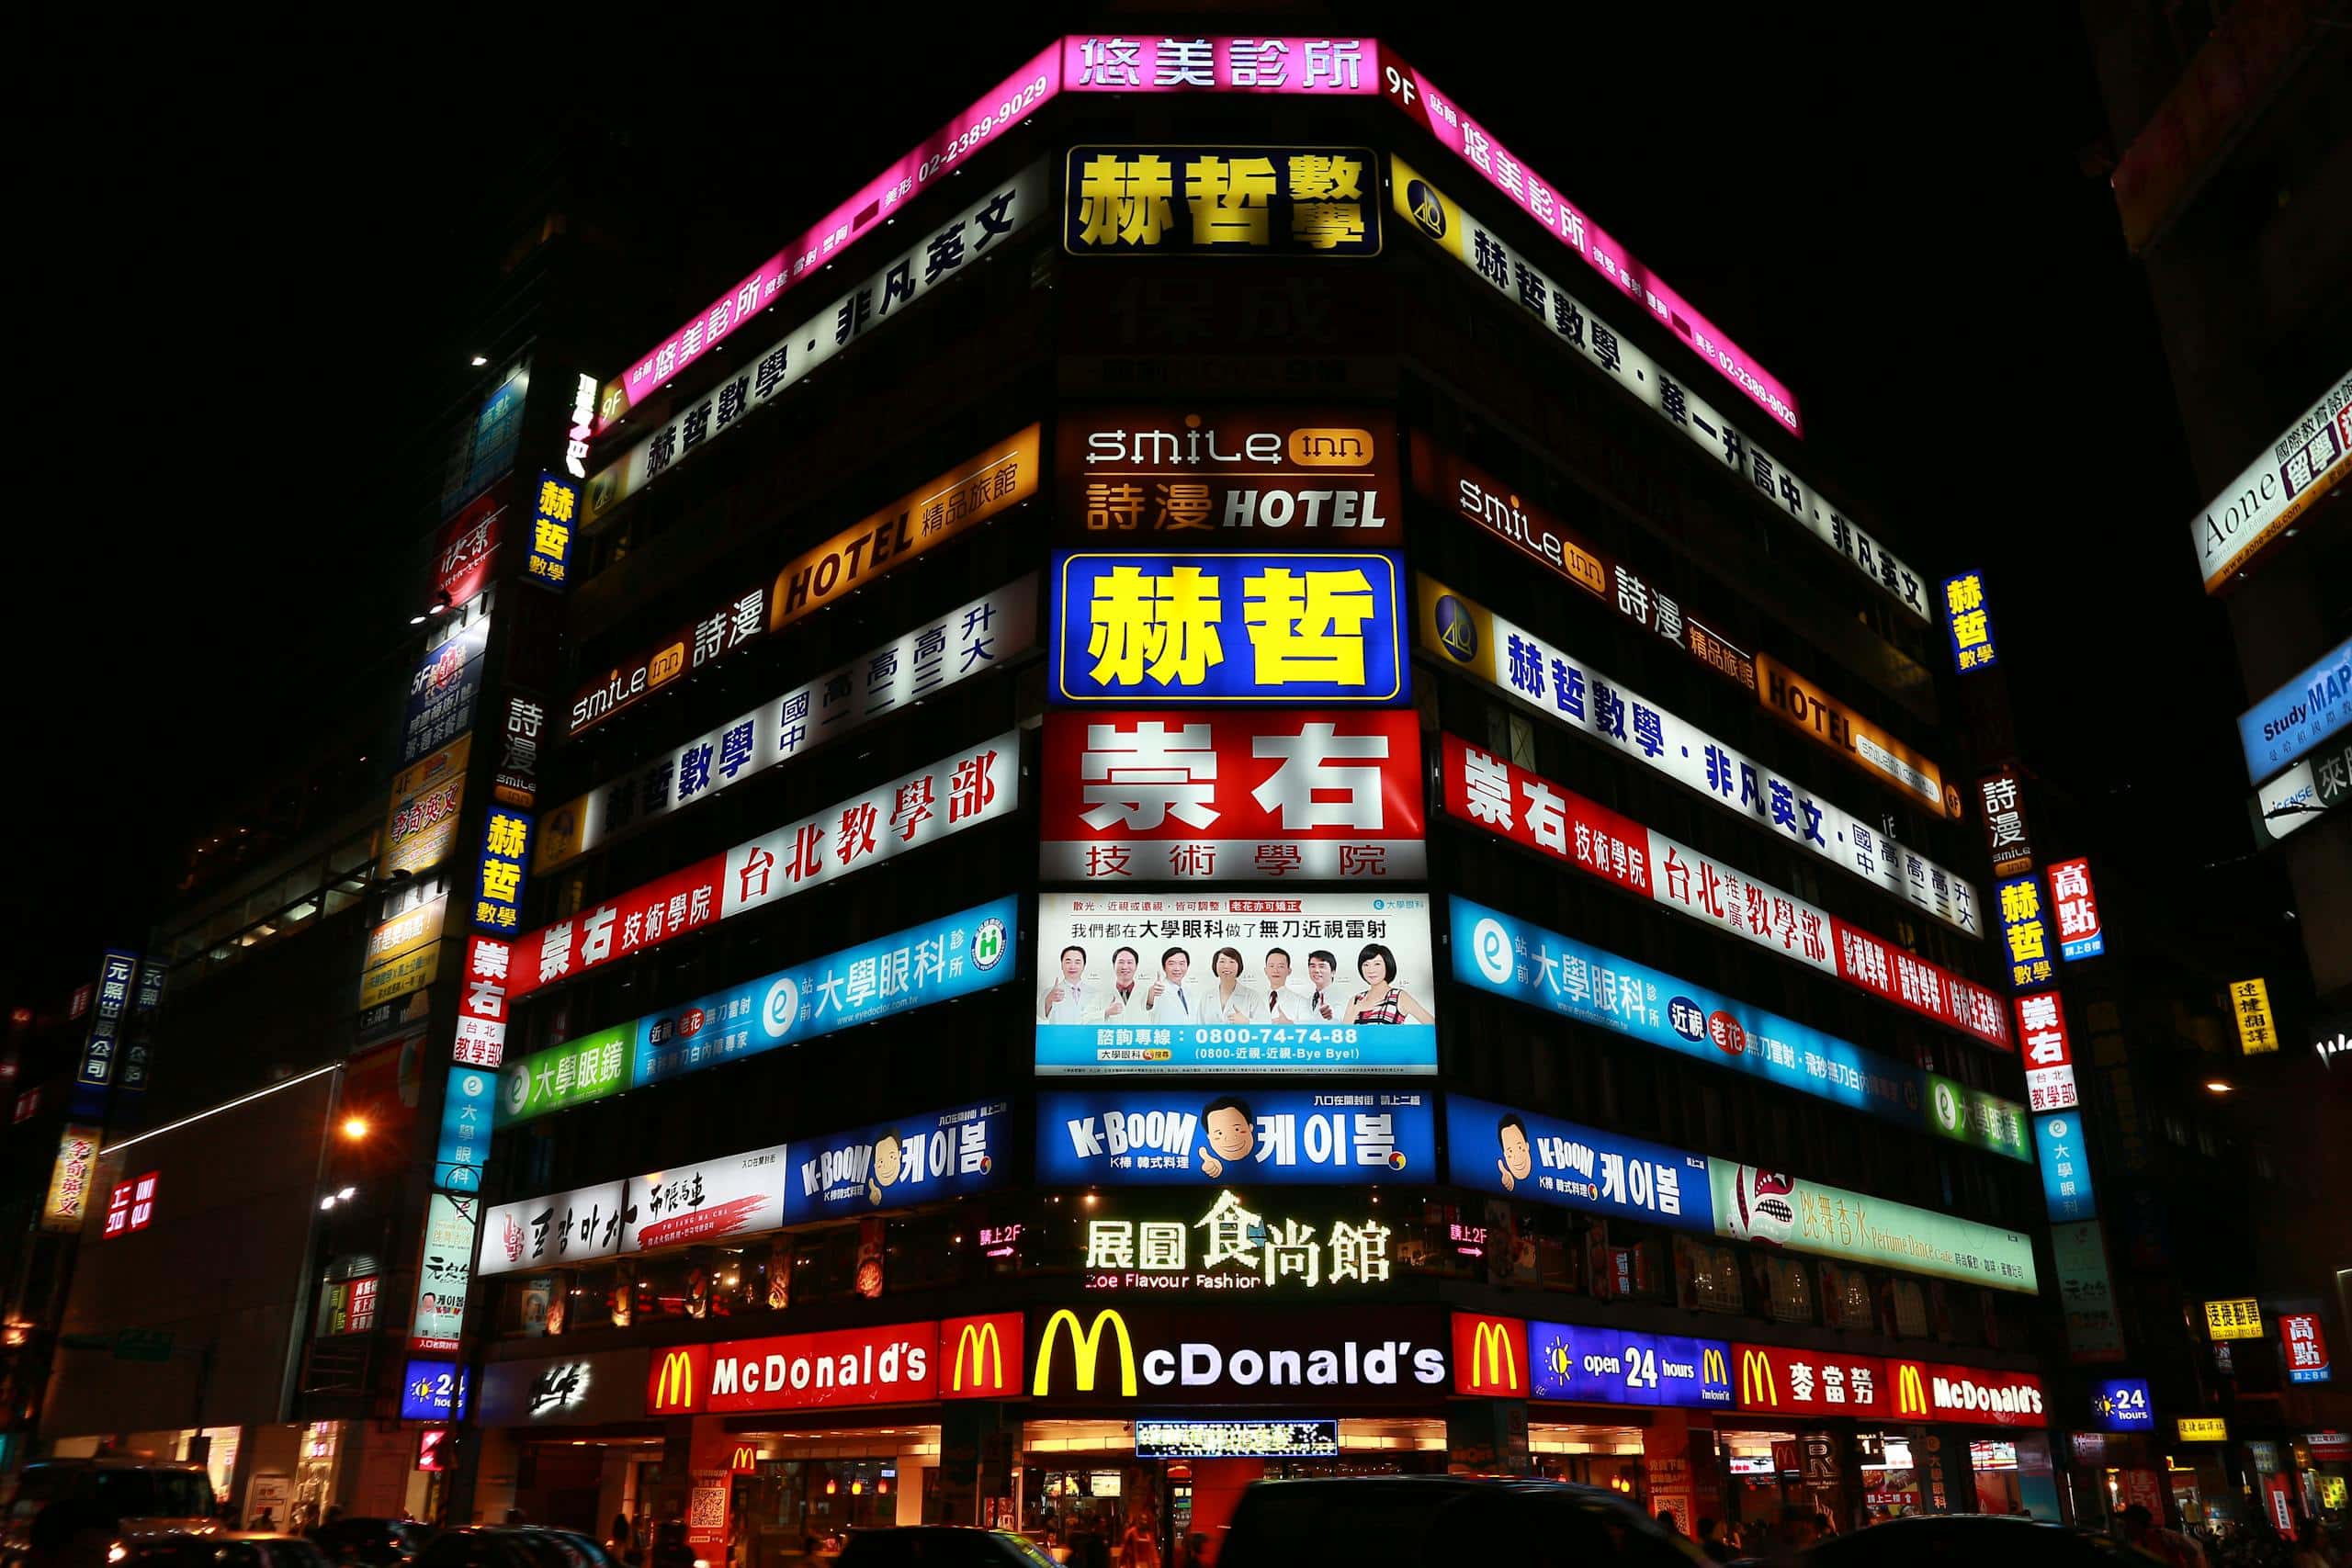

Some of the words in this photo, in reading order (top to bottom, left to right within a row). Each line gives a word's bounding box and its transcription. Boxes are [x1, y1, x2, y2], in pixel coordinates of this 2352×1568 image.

[1080, 38, 1362, 88] 悠美診所
[602, 389, 623, 421] 9F
[651, 275, 762, 385] 悠美診所
[919, 76, 1047, 182] 02-2389-9029
[1385, 66, 1416, 106] 9F
[1462, 121, 1587, 253] 悠美診所
[1719, 351, 1797, 428] 02-2389-9029
[1085, 482, 1215, 530] 詩漫
[1222, 490, 1386, 528] HOTEL
[2204, 472, 2278, 559] Aone
[692, 589, 763, 669] 詩漫
[784, 511, 916, 617] HOTEL
[921, 462, 1018, 536] 精品旅館
[2222, 502, 2302, 576] www.aone-edu.com
[1088, 566, 1374, 686] 赫哲
[778, 688, 810, 753] 國中
[911, 624, 947, 696] 高三
[959, 603, 997, 673] 升大
[1615, 564, 1686, 649] 詩漫
[1690, 626, 1756, 690] 精品旅館
[1769, 670, 1858, 752] HOTEL
[1959, 643, 1995, 670] 數學
[2264, 702, 2309, 742] Study
[2307, 663, 2352, 716] MAP
[502, 697, 544, 776] 詩漫
[1079, 721, 1389, 831] 崇右
[1983, 778, 2026, 849] 詩漫
[538, 905, 616, 983] 崇右
[622, 885, 712, 953] 技術學院
[738, 749, 999, 903] 台北教學部
[1085, 844, 1386, 876] 技術學院
[1852, 823, 1874, 875] 國中
[1386, 899, 1425, 910] 大學眼科
[1464, 747, 1567, 856] 崇右
[1574, 820, 1645, 888] 技術學院
[1841, 928, 1889, 993] 影視學群
[1897, 954, 1941, 1014] 設計學群
[2052, 863, 2098, 937] 高點
[476, 901, 517, 929] 數學
[1071, 919, 1386, 939] 我們都在大學眼科做了無刀近視雷射
[468, 940, 510, 1018] 崇右
[814, 933, 945, 1020] 大學眼科
[949, 928, 965, 979] 診所
[1532, 943, 1645, 1025] 大學眼科
[1670, 1002, 1705, 1038] 近視
[1711, 1016, 1745, 1052] 老花
[2013, 960, 2053, 987] 數學
[455, 1035, 503, 1067] 教學部
[465, 1021, 496, 1038] 台北
[1102, 1050, 1141, 1060] 大學眼科
[1154, 1051, 1170, 1059] 搜尋
[1195, 1028, 1358, 1044] 0800-74-74-88
[2021, 996, 2064, 1066] 崇右
[534, 1039, 625, 1103] 大學眼鏡
[2031, 1082, 2077, 1111] 教學部
[452, 1103, 478, 1185] 大學眼科
[899, 1121, 987, 1184] 케이봄
[1137, 1156, 1190, 1169] 韓式料理
[1255, 1113, 1396, 1167] 케이봄
[1600, 1152, 1680, 1215] 케이봄
[2053, 1144, 2080, 1214] 大學眼科
[979, 1224, 1022, 1246] 請上2F
[1450, 1224, 1487, 1244] 請上2F
[1871, 1225, 1907, 1255] Perfume
[1908, 1235, 1934, 1259] Dance
[1125, 1272, 1189, 1289] Flavour
[1033, 1309, 1446, 1396] McDonald's
[1584, 1352, 1620, 1378] open
[1625, 1347, 1657, 1388] 24
[1663, 1359, 1694, 1380] hours
[2287, 1316, 2322, 1366] 高點
[711, 1342, 927, 1395] McDonald's
[1790, 1361, 1874, 1405] 麥當勞
[433, 1396, 463, 1408] hous
[1933, 1377, 2043, 1415] McDonald's
[2116, 1389, 2144, 1409] 24
[2119, 1410, 2148, 1420] hours
